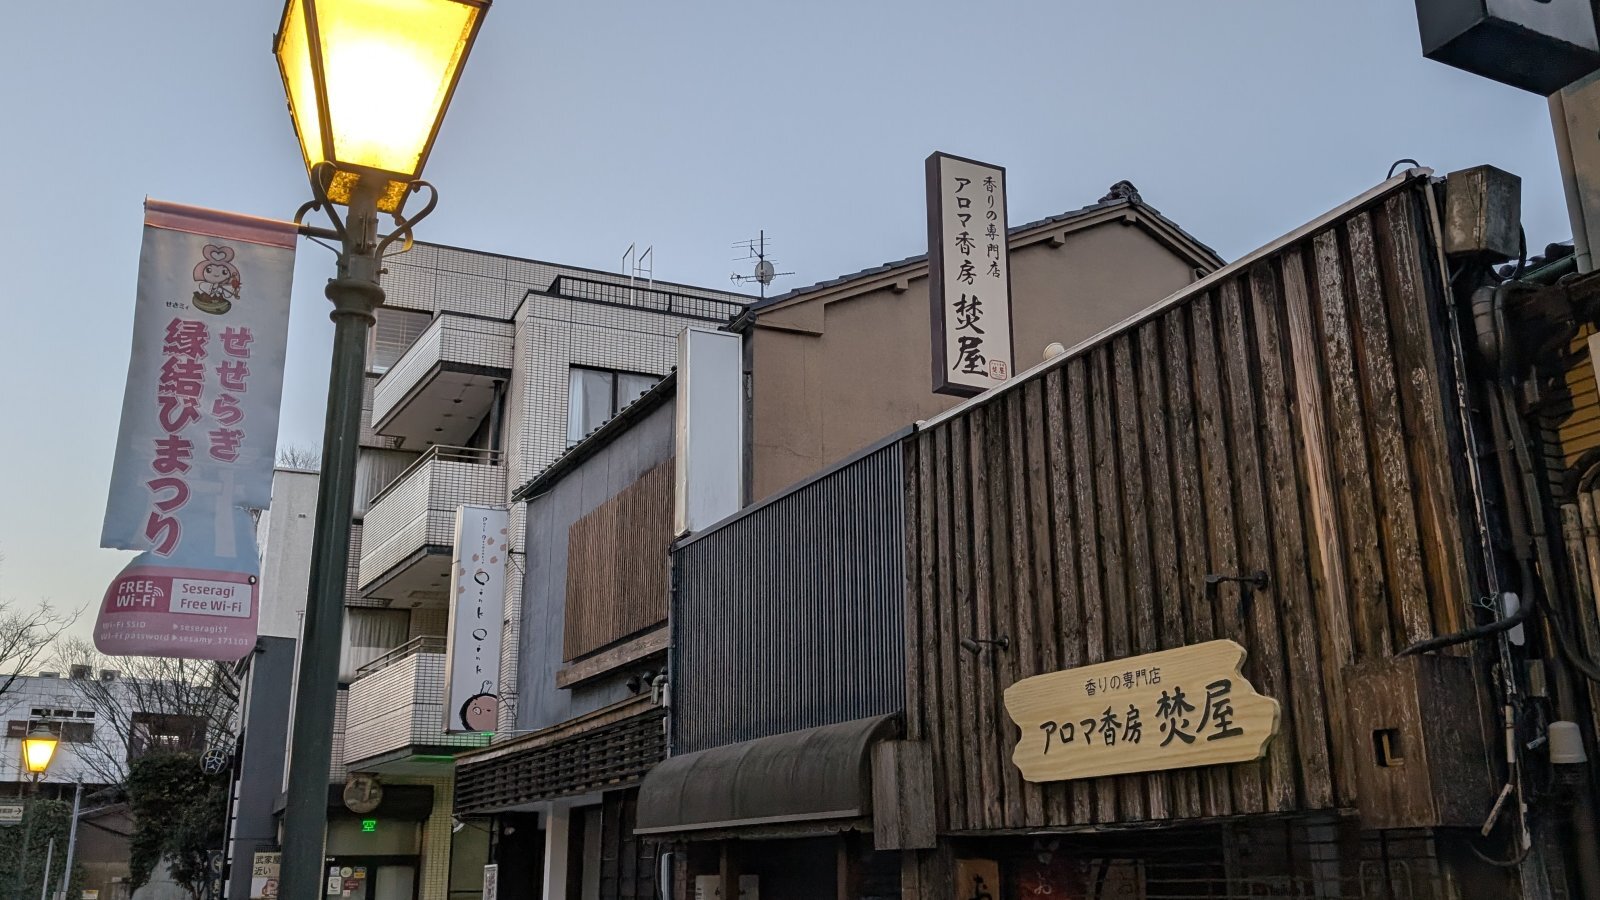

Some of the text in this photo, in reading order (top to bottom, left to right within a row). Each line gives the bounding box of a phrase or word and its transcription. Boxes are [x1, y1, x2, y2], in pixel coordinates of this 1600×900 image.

[983, 176, 1001, 279] 香りの専門店
[952, 176, 989, 378] アロマ香房 焚屋
[209, 326, 253, 462] せせらぎ
[145, 317, 209, 557] 縁結びまつり
[118, 580, 153, 594] FREE
[182, 583, 235, 597] Seseragi
[116, 594, 156, 608] Wi-Fi
[180, 598, 242, 613] Free Wi-Fi
[126, 621, 146, 629] SSID
[472, 572, 489, 674] Oink Oink
[125, 633, 169, 641] password
[1084, 666, 1162, 697] 香りの専門店
[1039, 678, 1244, 755] アロマ香房 焚屋
[362, 820, 376, 832] 空
